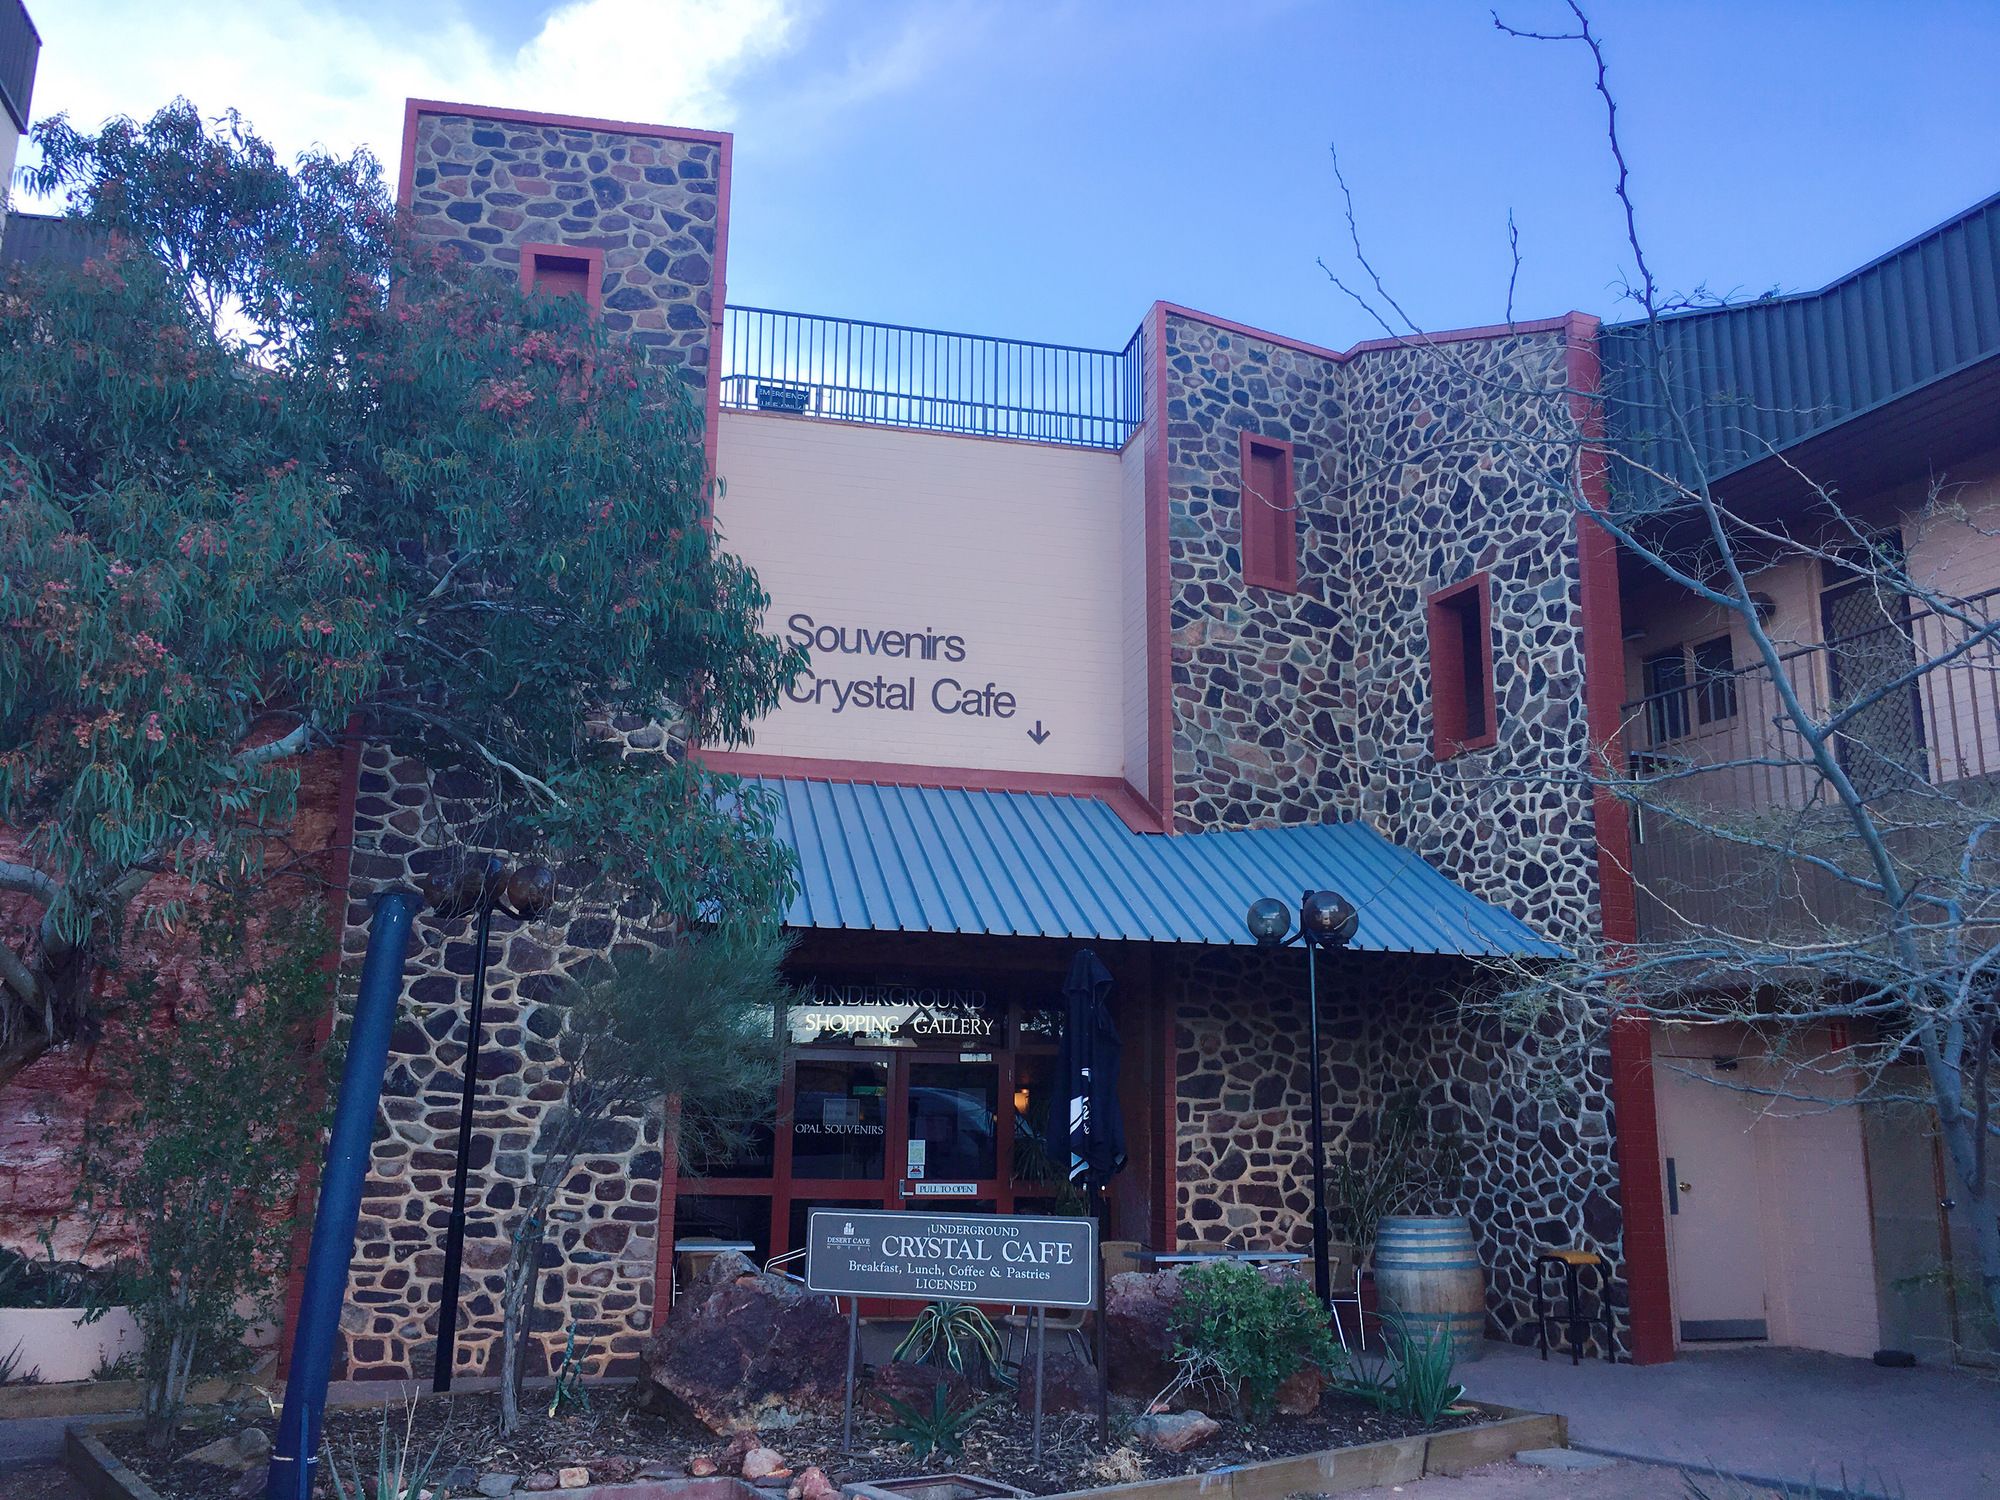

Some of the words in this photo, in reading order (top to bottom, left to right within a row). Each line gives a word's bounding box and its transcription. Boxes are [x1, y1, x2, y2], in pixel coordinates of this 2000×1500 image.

[759, 388, 808, 400] EMERGENCY
[786, 614, 966, 662] Souvenirs
[785, 669, 915, 713] Crystal
[931, 678, 1017, 718] Cafe
[813, 985, 986, 1009] UNDERGROUND
[806, 1013, 899, 1033] SHOPPING
[914, 1017, 994, 1036] GALLERY
[795, 1124, 822, 1134] OPAL
[825, 1124, 884, 1135] SOUVENIRS
[919, 1185, 938, 1193] PULL
[931, 1224, 1019, 1237] UNDERGROUND
[827, 1236, 851, 1244] DESERT
[882, 1236, 992, 1261] CRYSTAL
[1003, 1241, 1074, 1265] CAFE
[849, 1260, 902, 1274] Breakfast,
[907, 1264, 945, 1276] Lunch,
[949, 1265, 985, 1278] Coffee
[990, 1267, 1001, 1278] &
[1007, 1267, 1050, 1280] Pastries
[916, 1278, 977, 1292] LICENSED
